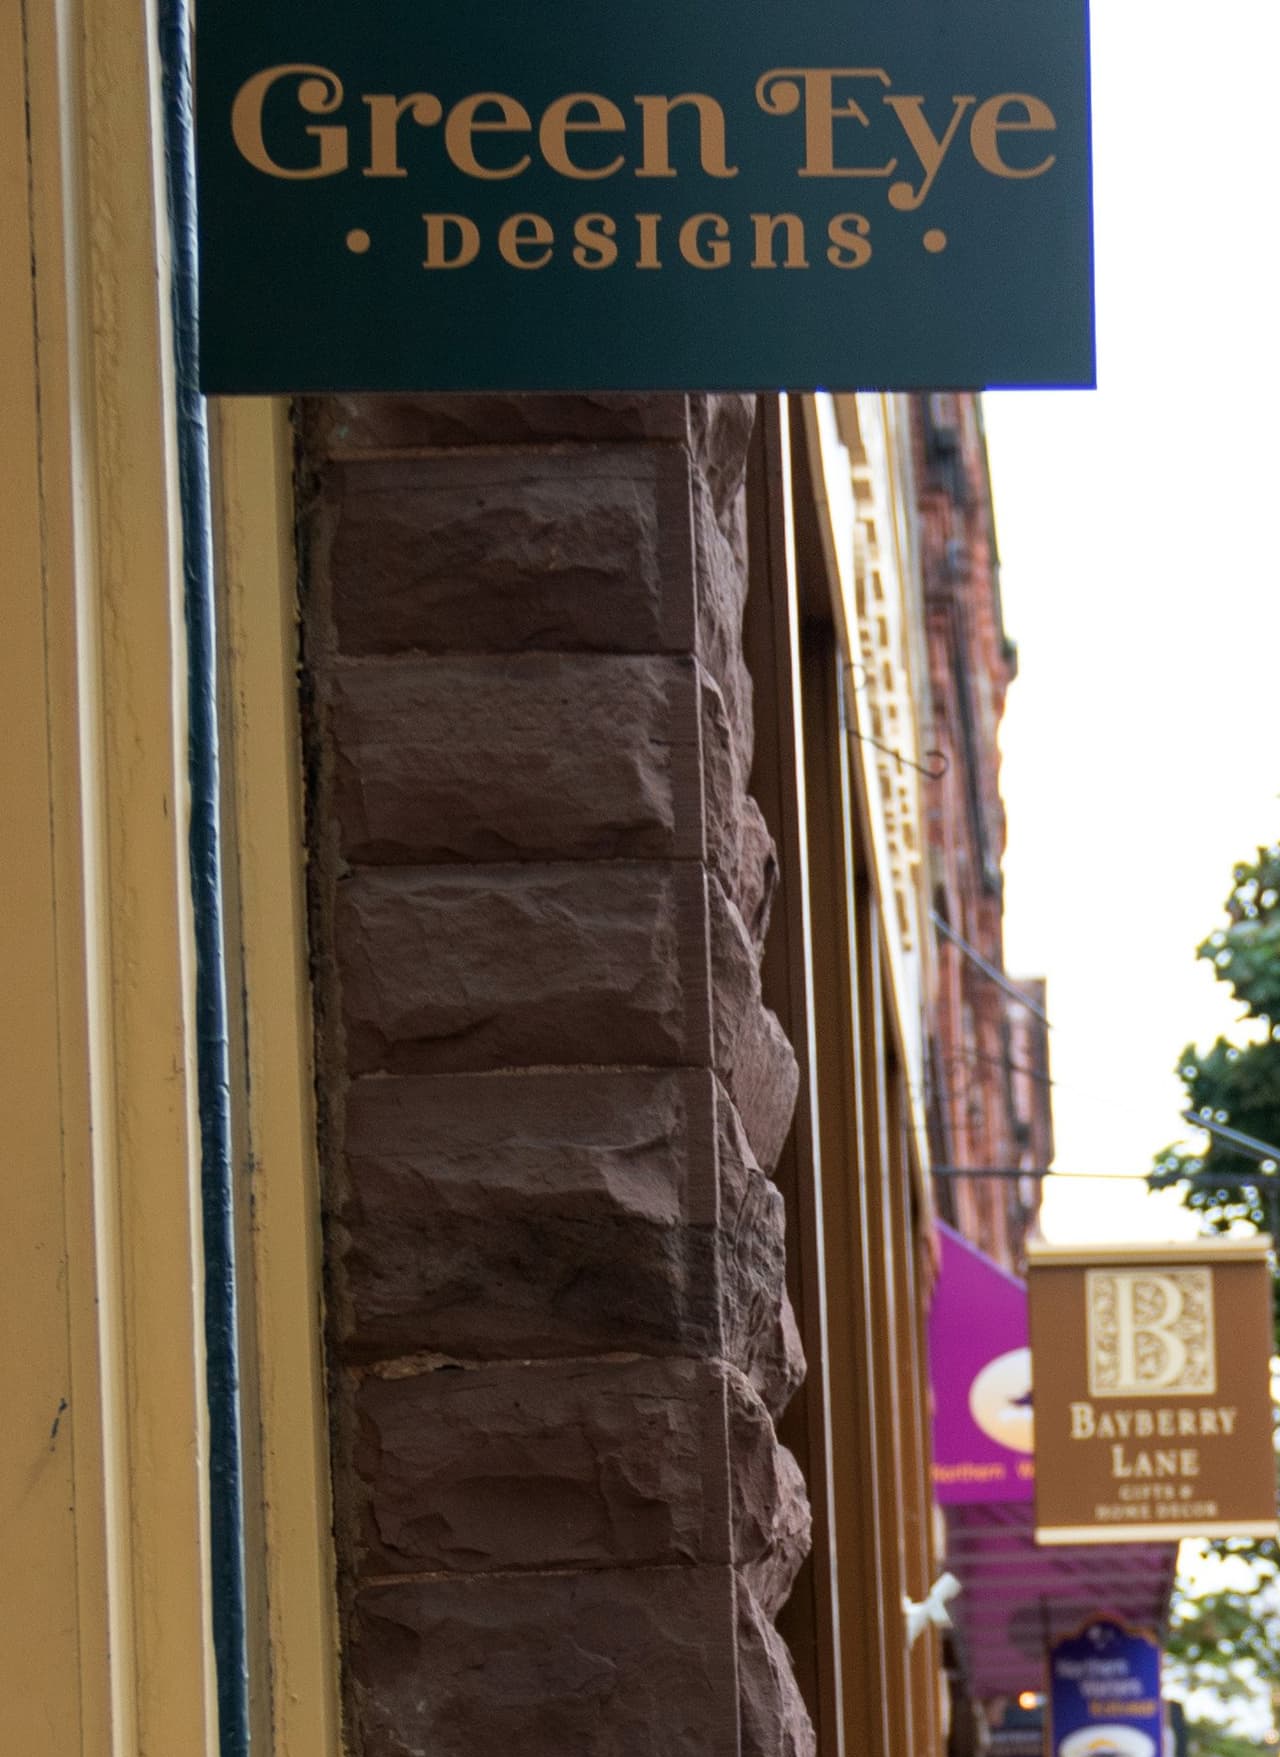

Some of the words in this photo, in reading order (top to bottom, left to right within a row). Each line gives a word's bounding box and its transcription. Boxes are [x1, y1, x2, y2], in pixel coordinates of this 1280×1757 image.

[231, 63, 739, 180] Green
[754, 66, 1058, 212] Eye
[1111, 1443, 1201, 1478] LANE
